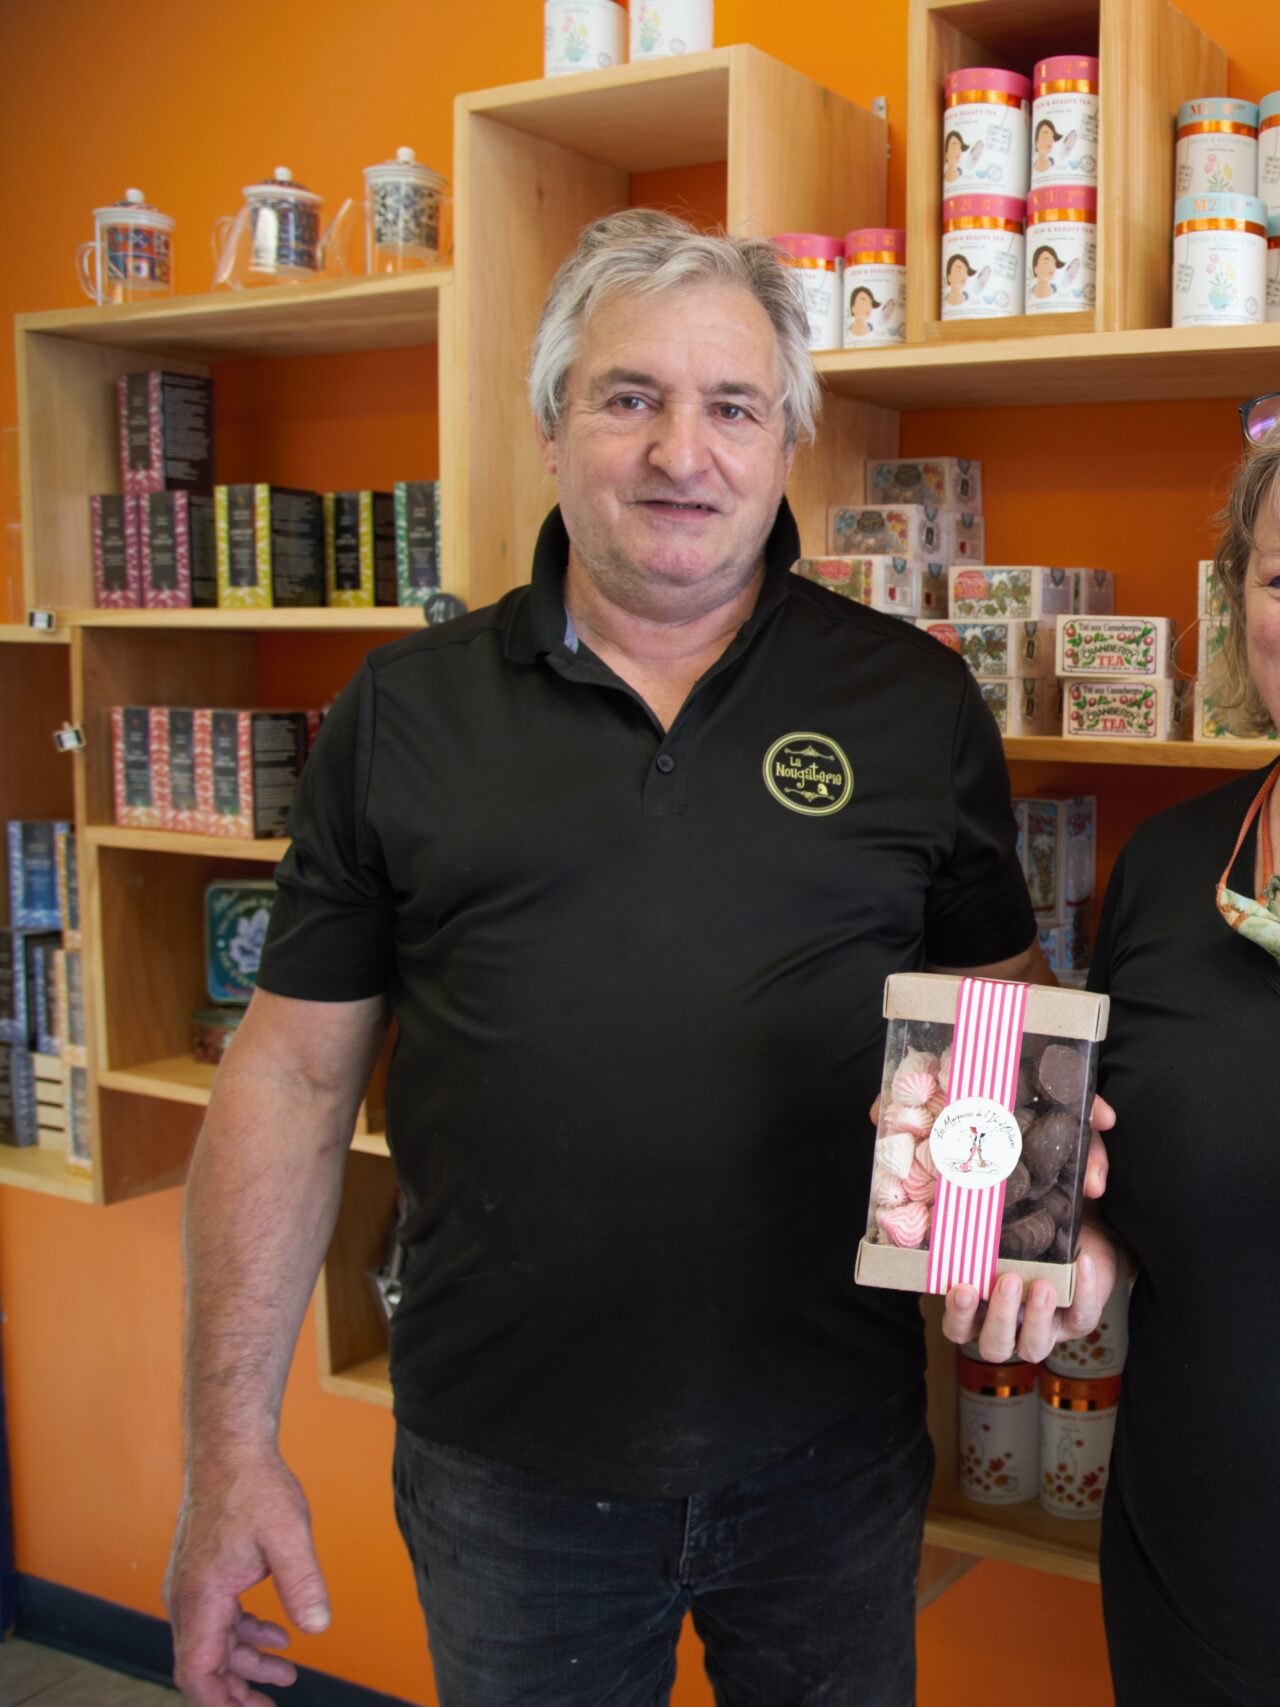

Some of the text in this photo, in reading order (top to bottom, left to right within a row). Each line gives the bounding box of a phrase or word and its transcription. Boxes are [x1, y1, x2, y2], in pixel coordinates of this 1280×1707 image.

[1053, 225, 1081, 233] BEAUTY
[1082, 644, 1137, 659] CRANBERRY
[1097, 655, 1125, 667] TEA
[1086, 706, 1138, 721] CRANBERRY
[1101, 718, 1127, 730] TEA
[789, 756, 802, 767] La
[775, 761, 842, 789] Nougaterie
